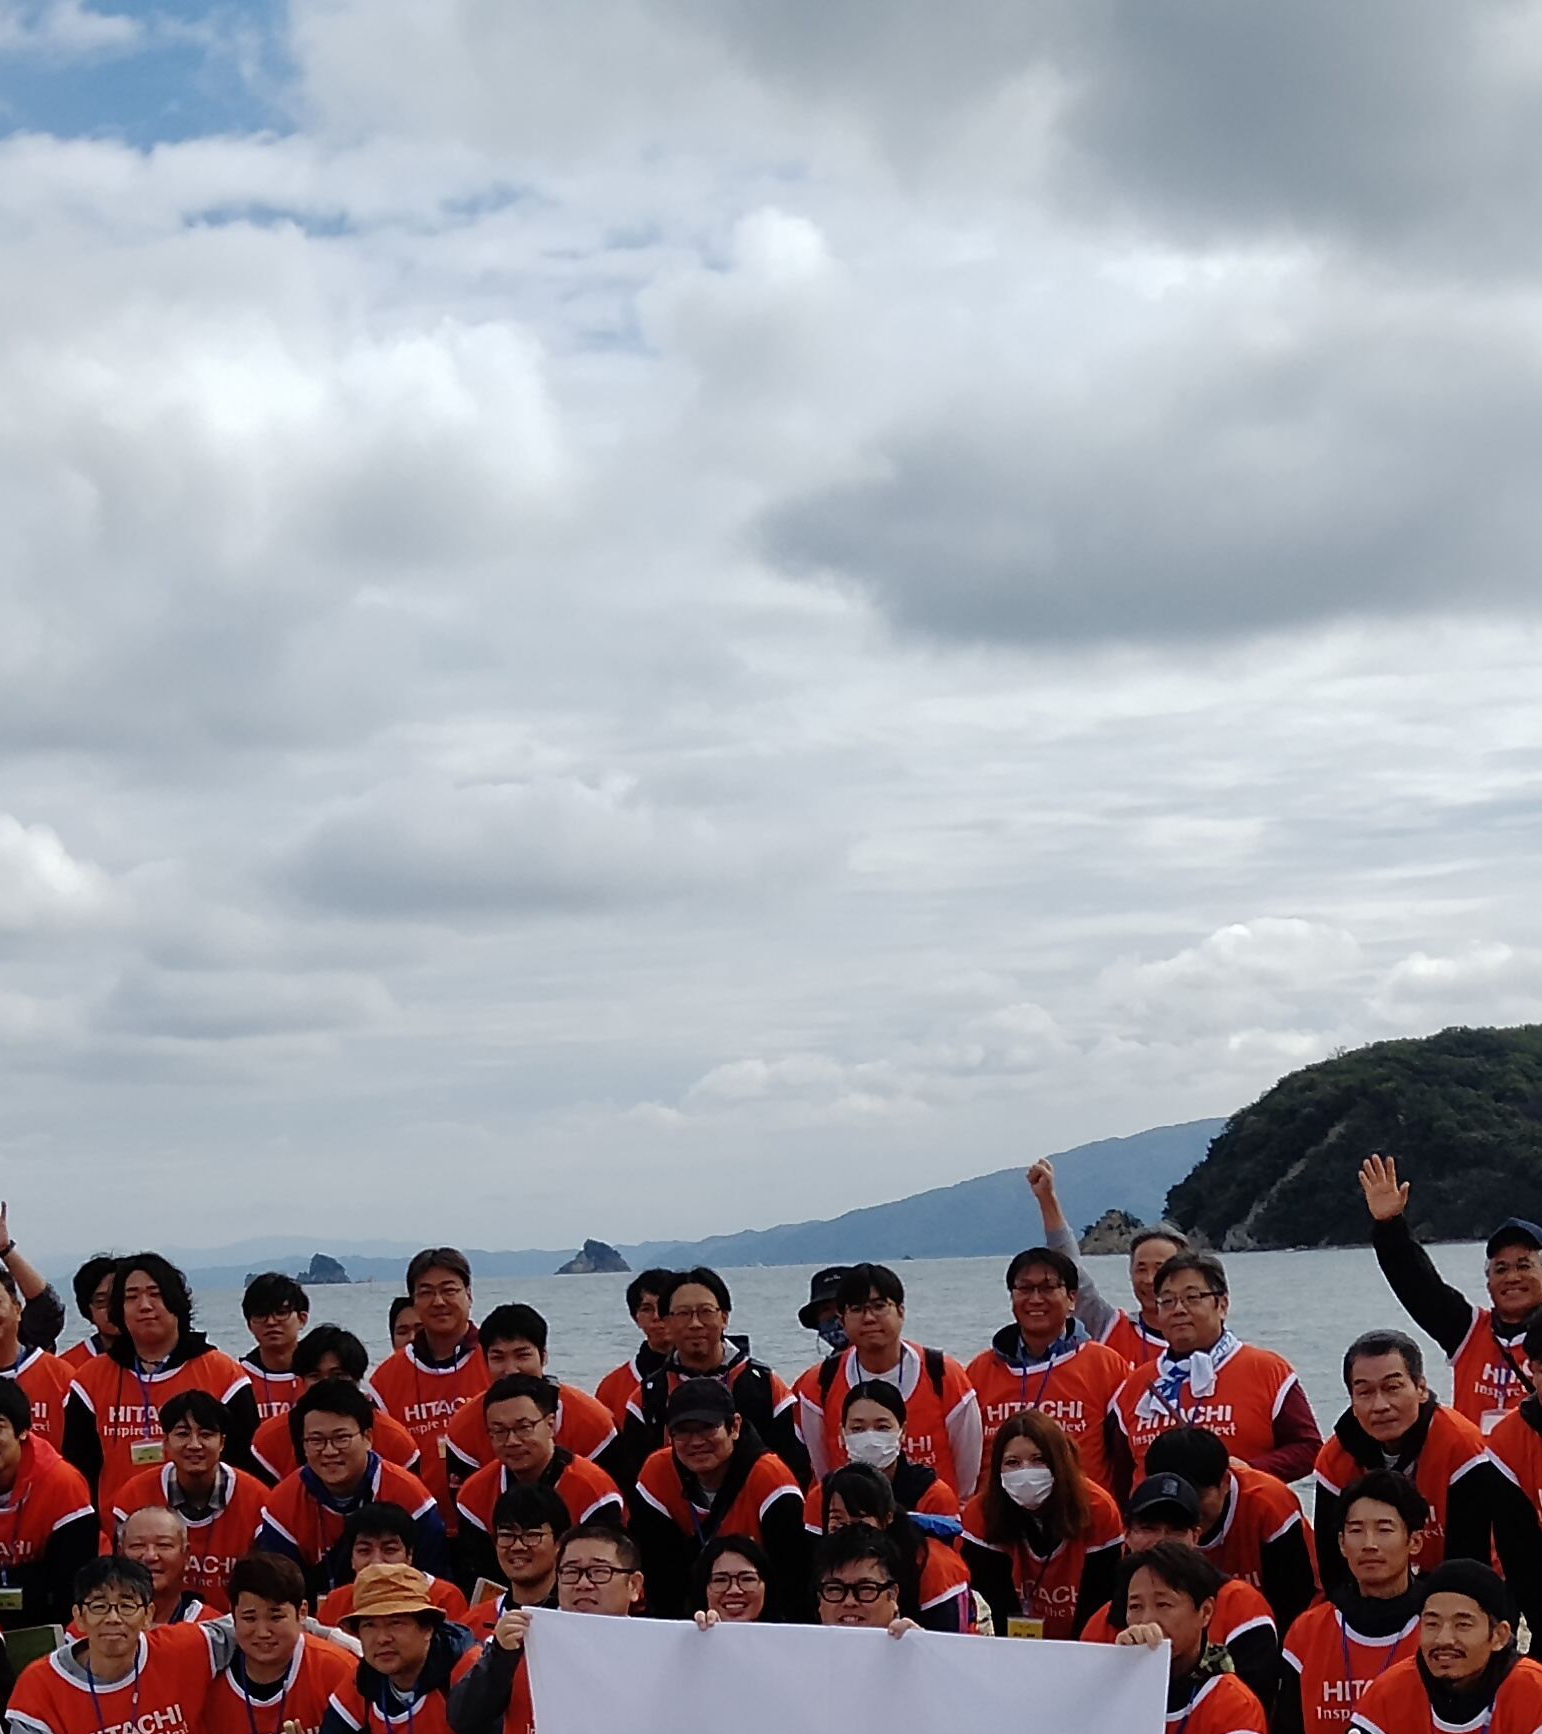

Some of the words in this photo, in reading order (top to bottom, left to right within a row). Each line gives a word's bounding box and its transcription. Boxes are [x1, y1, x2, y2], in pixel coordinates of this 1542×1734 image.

[109, 1405, 160, 1423] HITA
[1136, 1405, 1233, 1432] HICHI
[150, 1423, 164, 1436] th
[1316, 1705, 1352, 1723] Insp
